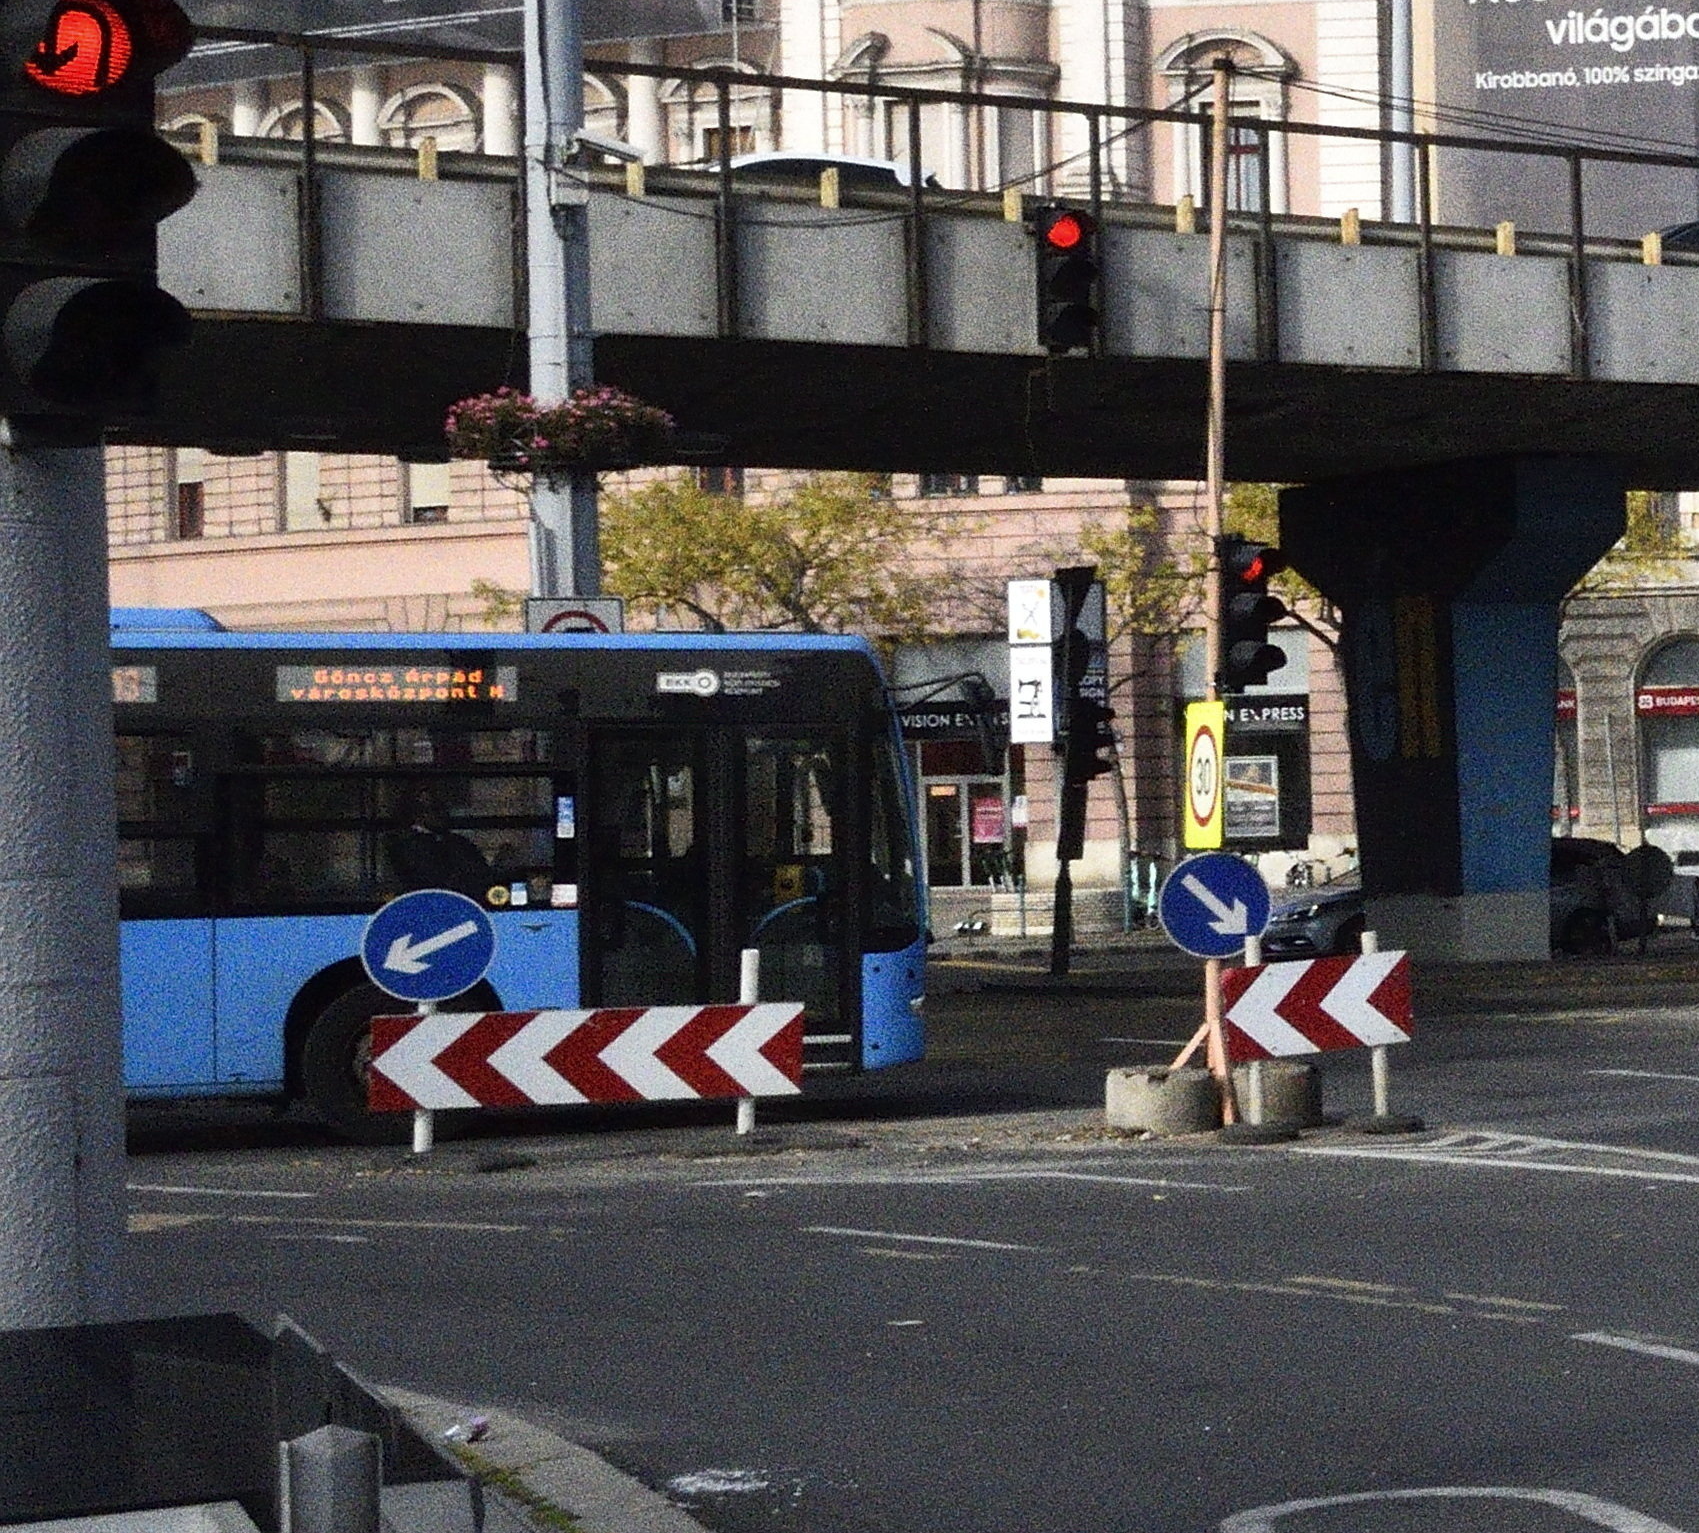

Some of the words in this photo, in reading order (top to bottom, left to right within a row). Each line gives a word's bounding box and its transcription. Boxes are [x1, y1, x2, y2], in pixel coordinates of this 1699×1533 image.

[1584, 66, 1630, 84] 100%
[902, 714, 950, 728] VISION
[1240, 707, 1305, 721] EXPRESS
